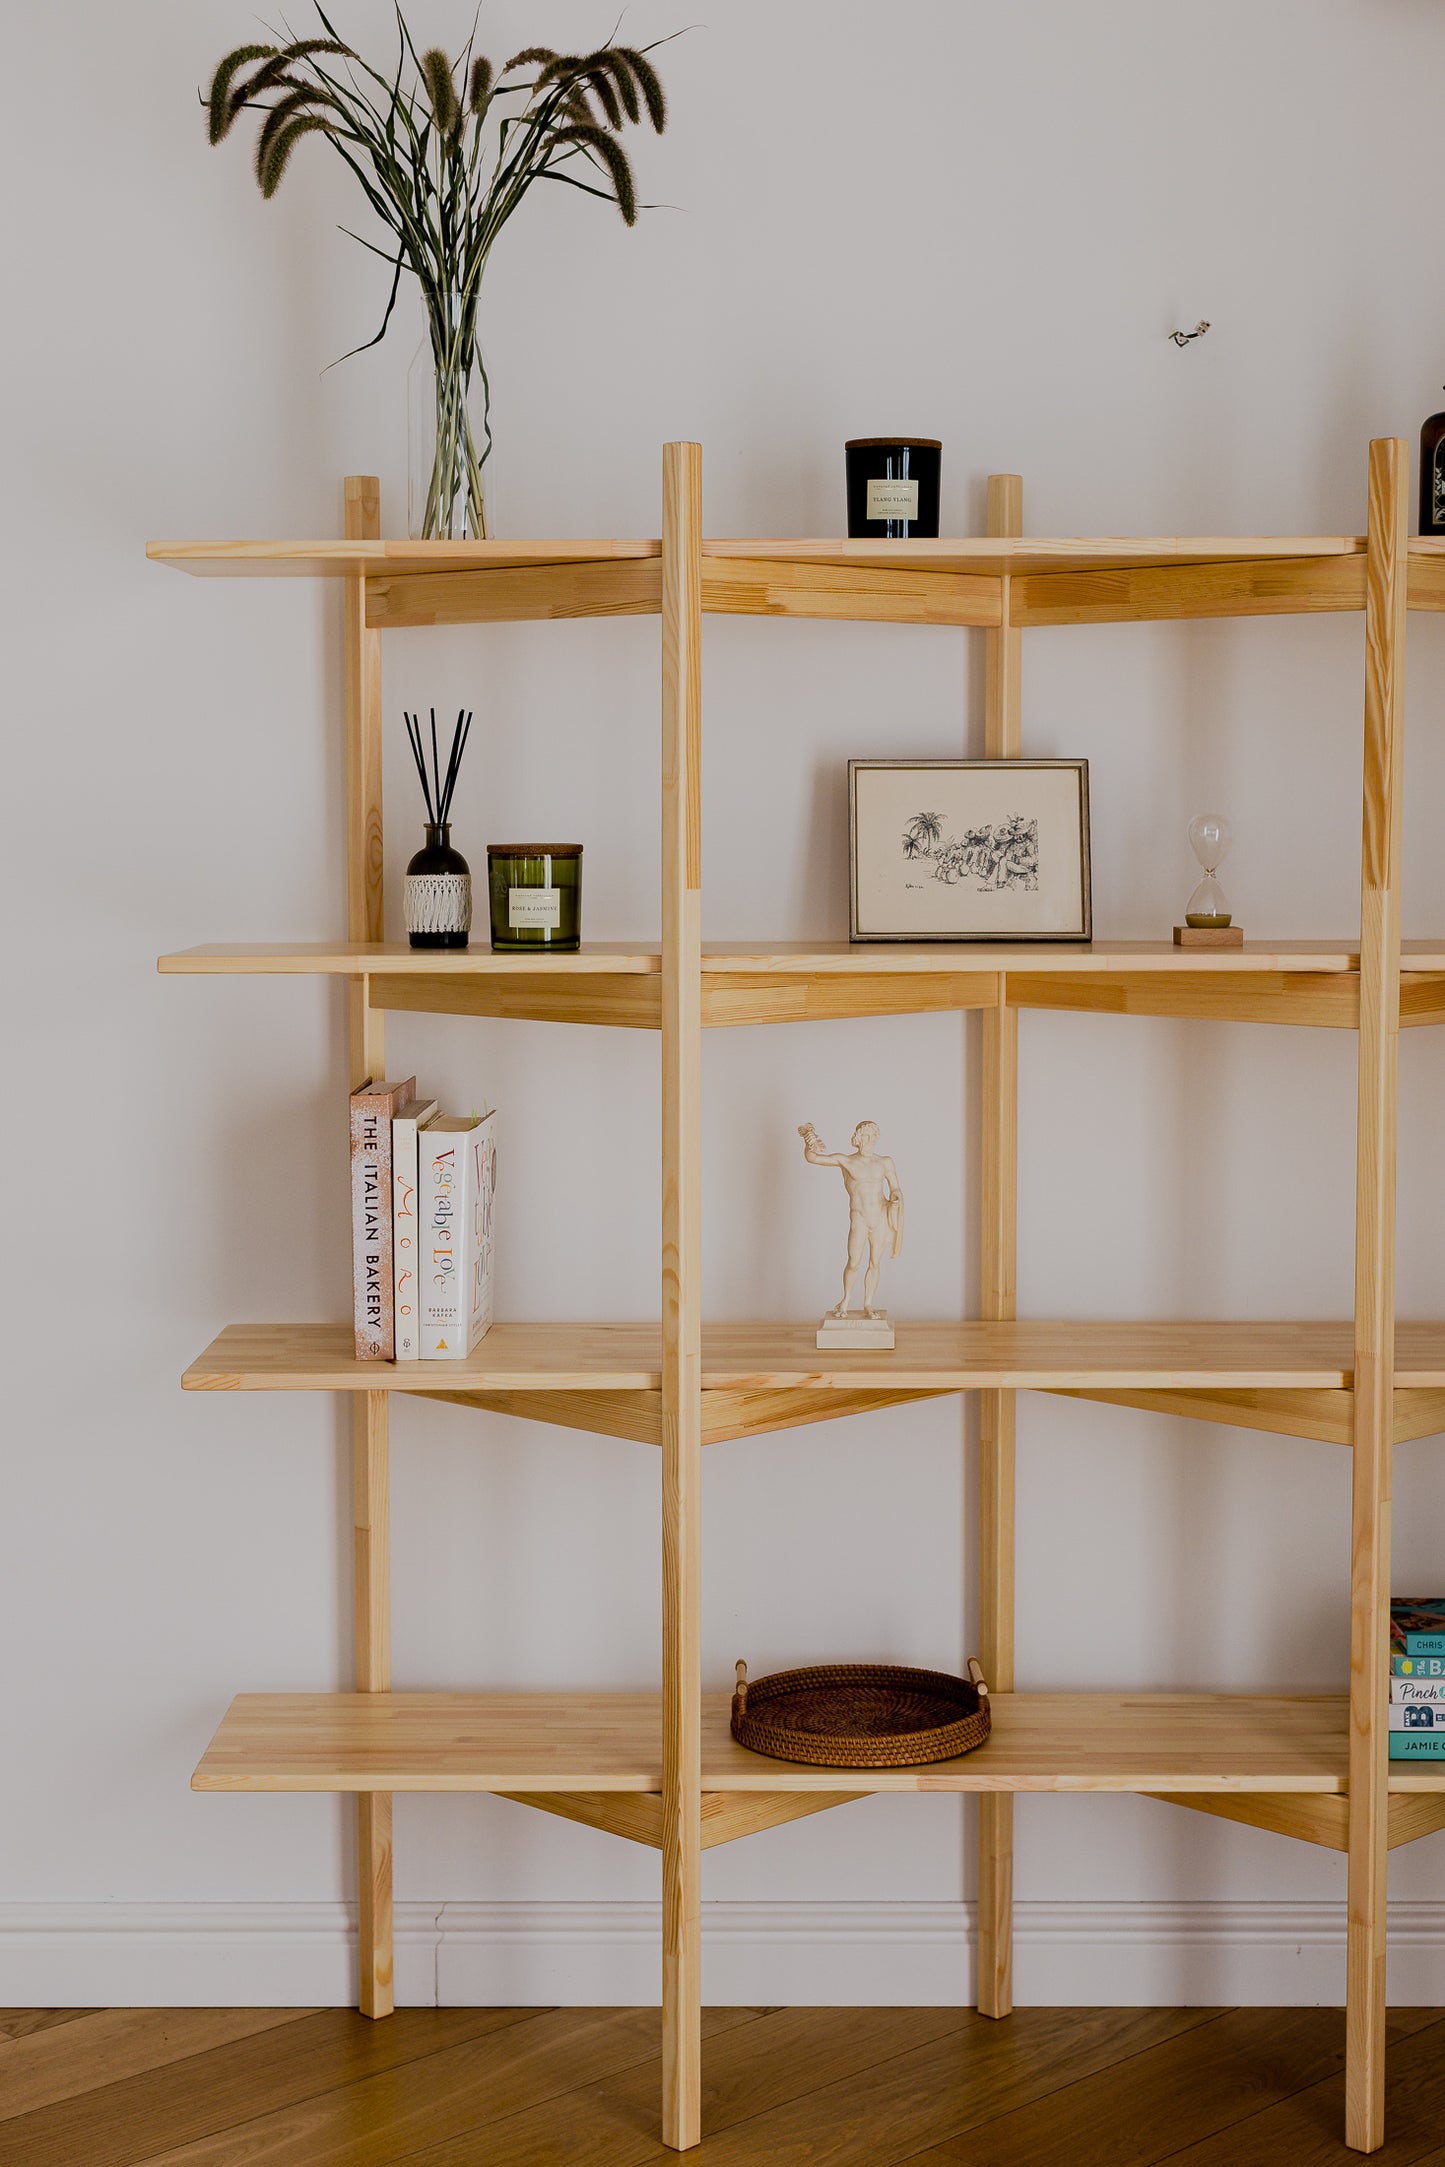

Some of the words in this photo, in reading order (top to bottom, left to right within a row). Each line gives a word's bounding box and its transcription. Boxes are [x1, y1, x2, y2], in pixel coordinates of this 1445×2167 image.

[364, 1116, 377, 1150] THE
[364, 1165, 379, 1240] ITALIAN
[431, 1148, 456, 1241] Vegetable
[397, 1175, 414, 1316] MORO
[366, 1255, 381, 1328] BAKERY
[433, 1247, 455, 1294] Love
[1416, 1641, 1443, 1649] CHRIS
[1399, 1682, 1439, 1701] Pinch
[1404, 1742, 1439, 1750] JAMIE
